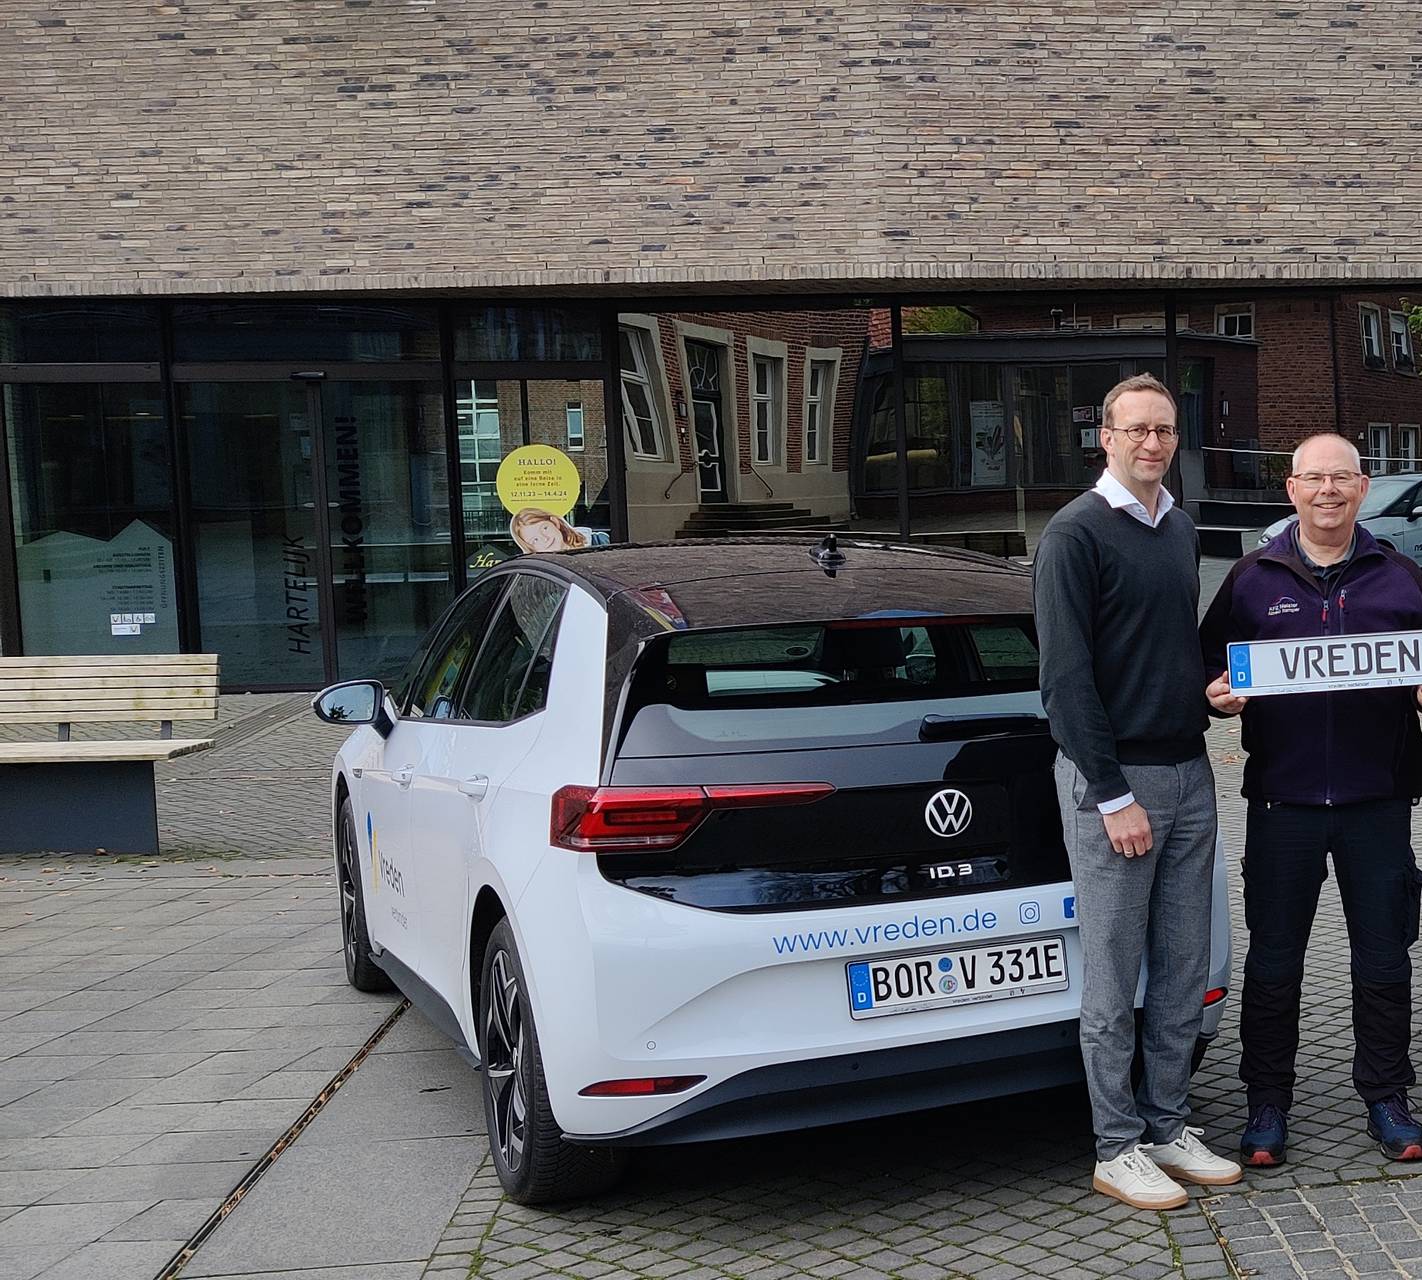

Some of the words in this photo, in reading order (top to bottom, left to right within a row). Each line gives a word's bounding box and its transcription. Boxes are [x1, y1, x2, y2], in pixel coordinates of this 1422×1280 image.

[518, 458, 556, 466] HALLO!
[282, 534, 311, 655] HARTELIJK
[1237, 671, 1246, 682] D
[1279, 639, 1421, 680] VREDEN
[773, 909, 998, 953] www.vreden.de
[857, 991, 867, 1003] D
[871, 960, 936, 1002] BOR
[959, 955, 976, 989] V
[986, 944, 1063, 985] 331E
